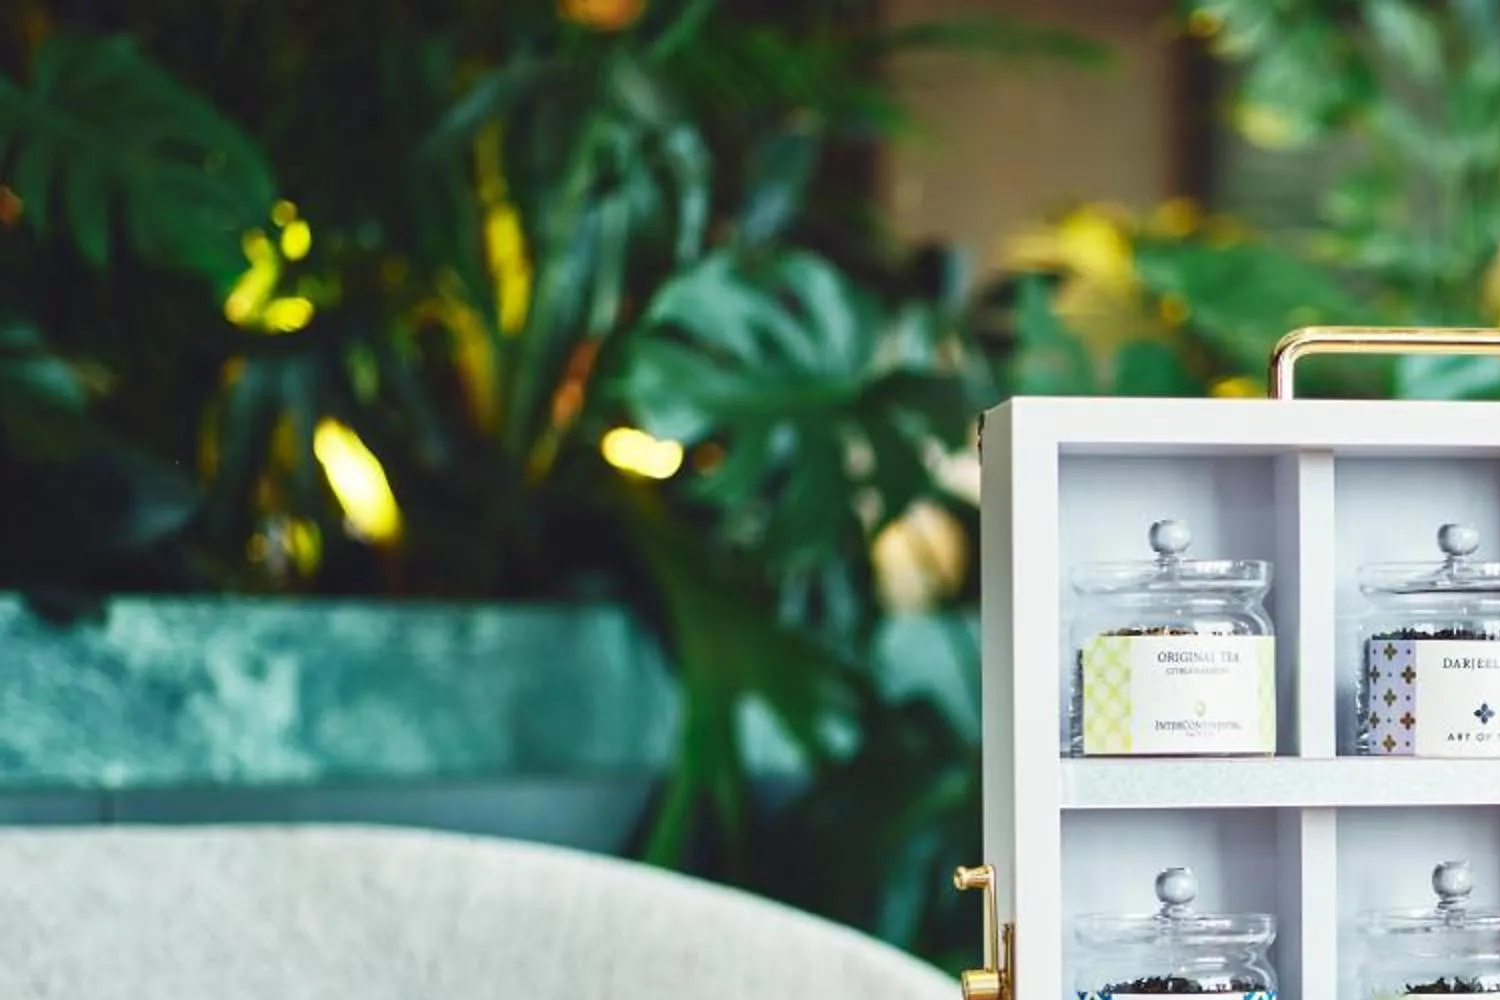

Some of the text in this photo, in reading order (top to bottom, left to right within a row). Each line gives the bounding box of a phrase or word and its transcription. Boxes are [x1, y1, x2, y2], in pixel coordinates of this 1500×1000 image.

[1157, 650, 1215, 663] ORIGINAL
[1448, 733, 1470, 741] ART
[1476, 733, 1492, 742] OF
